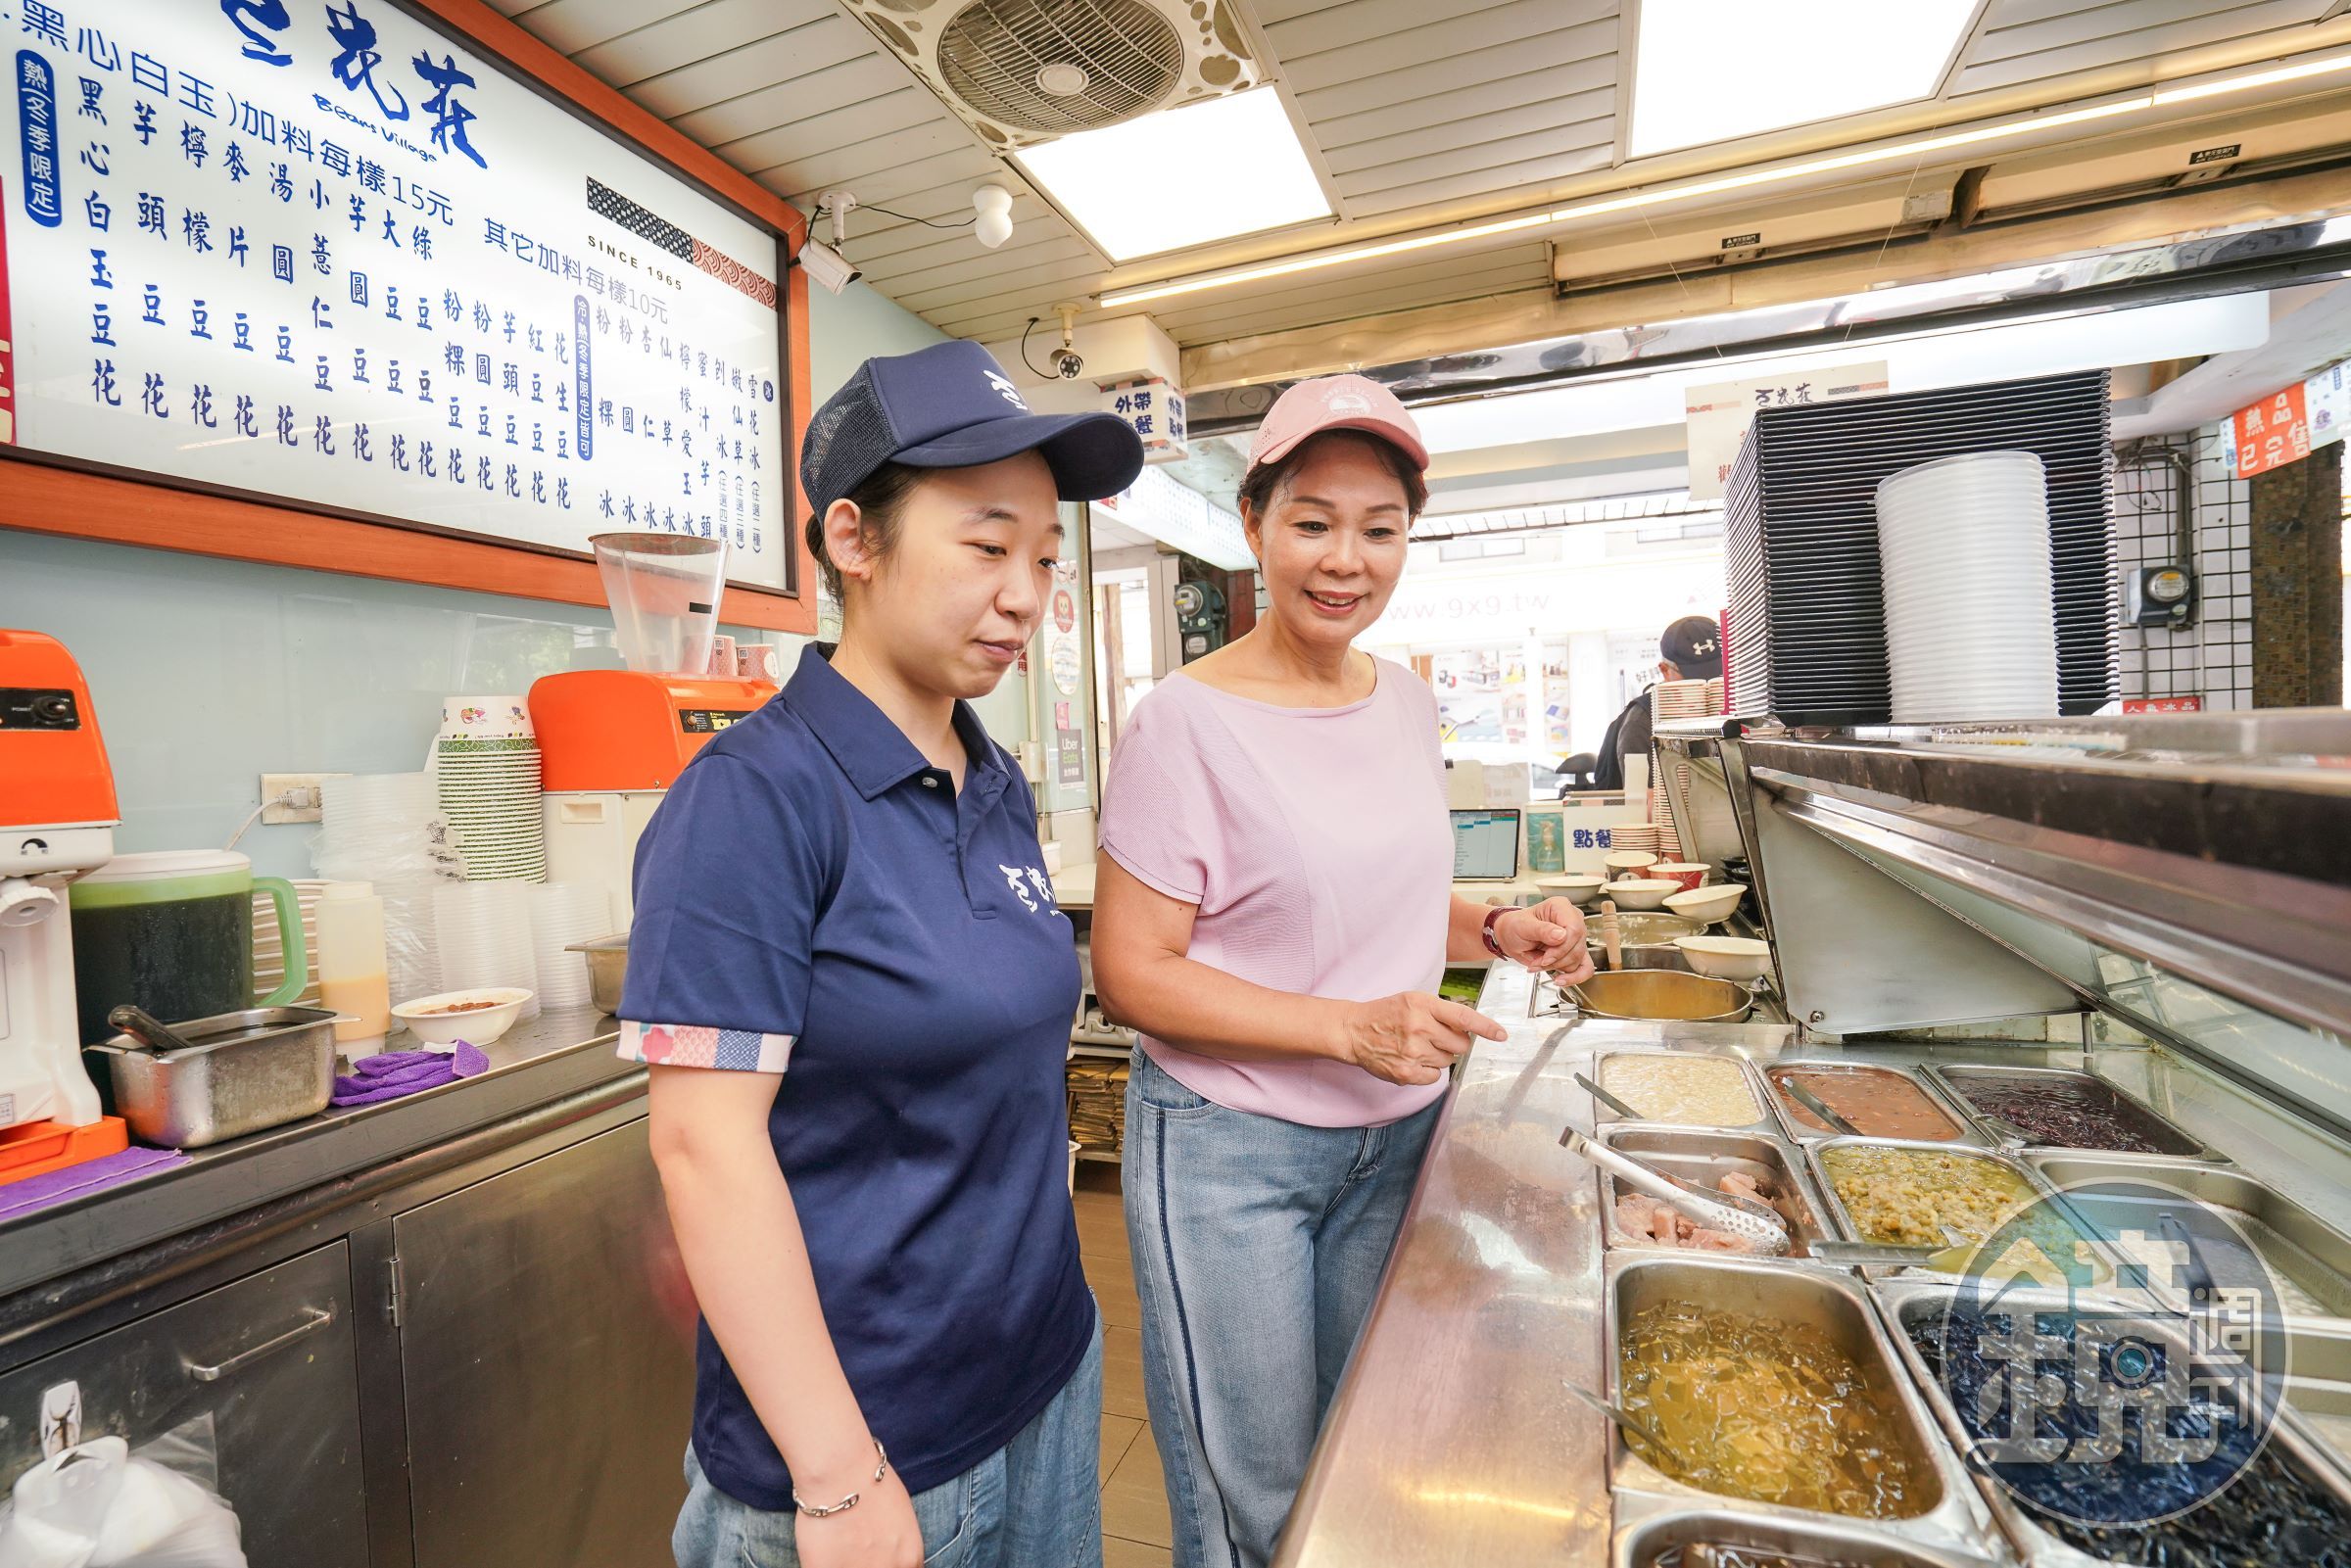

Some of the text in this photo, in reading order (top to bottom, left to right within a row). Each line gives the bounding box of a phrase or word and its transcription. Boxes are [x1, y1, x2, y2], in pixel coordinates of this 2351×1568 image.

[22, 59, 60, 217] 熱(冬季限定)
[380, 125, 438, 163] Village
[76, 75, 122, 406] 黑心白玉豆花
[133, 99, 170, 419] 芋頭豆花
[180, 119, 216, 428] 檸檬豆花
[222, 140, 259, 438] 麥片豆花
[267, 162, 298, 447] 湯圓豆花
[310, 179, 336, 456] 小薏仁豆花
[348, 194, 373, 462] 芋圓豆花
[484, 217, 669, 325] 其它加料每樣10元
[587, 235, 683, 291] SINCE 1965
[382, 209, 410, 472] 大豆豆花
[412, 225, 438, 478] 綠豆豆花
[443, 288, 465, 485] 粉粿豆花
[473, 300, 494, 491] 粉圓豆花
[503, 310, 520, 498] 芋頭豆花
[528, 323, 548, 504] 紅豆豆花
[554, 332, 571, 509] 花生豆花
[596, 305, 615, 519] 粉粿冰
[619, 315, 638, 525] 粉圓冰
[642, 325, 658, 530] 杏仁冰
[659, 336, 677, 533] 仙草冰
[1115, 392, 1152, 413] 外帶
[1125, 414, 1154, 434] 餐
[1061, 738, 1079, 750] Uber
[1573, 829, 1611, 849] 點餐
